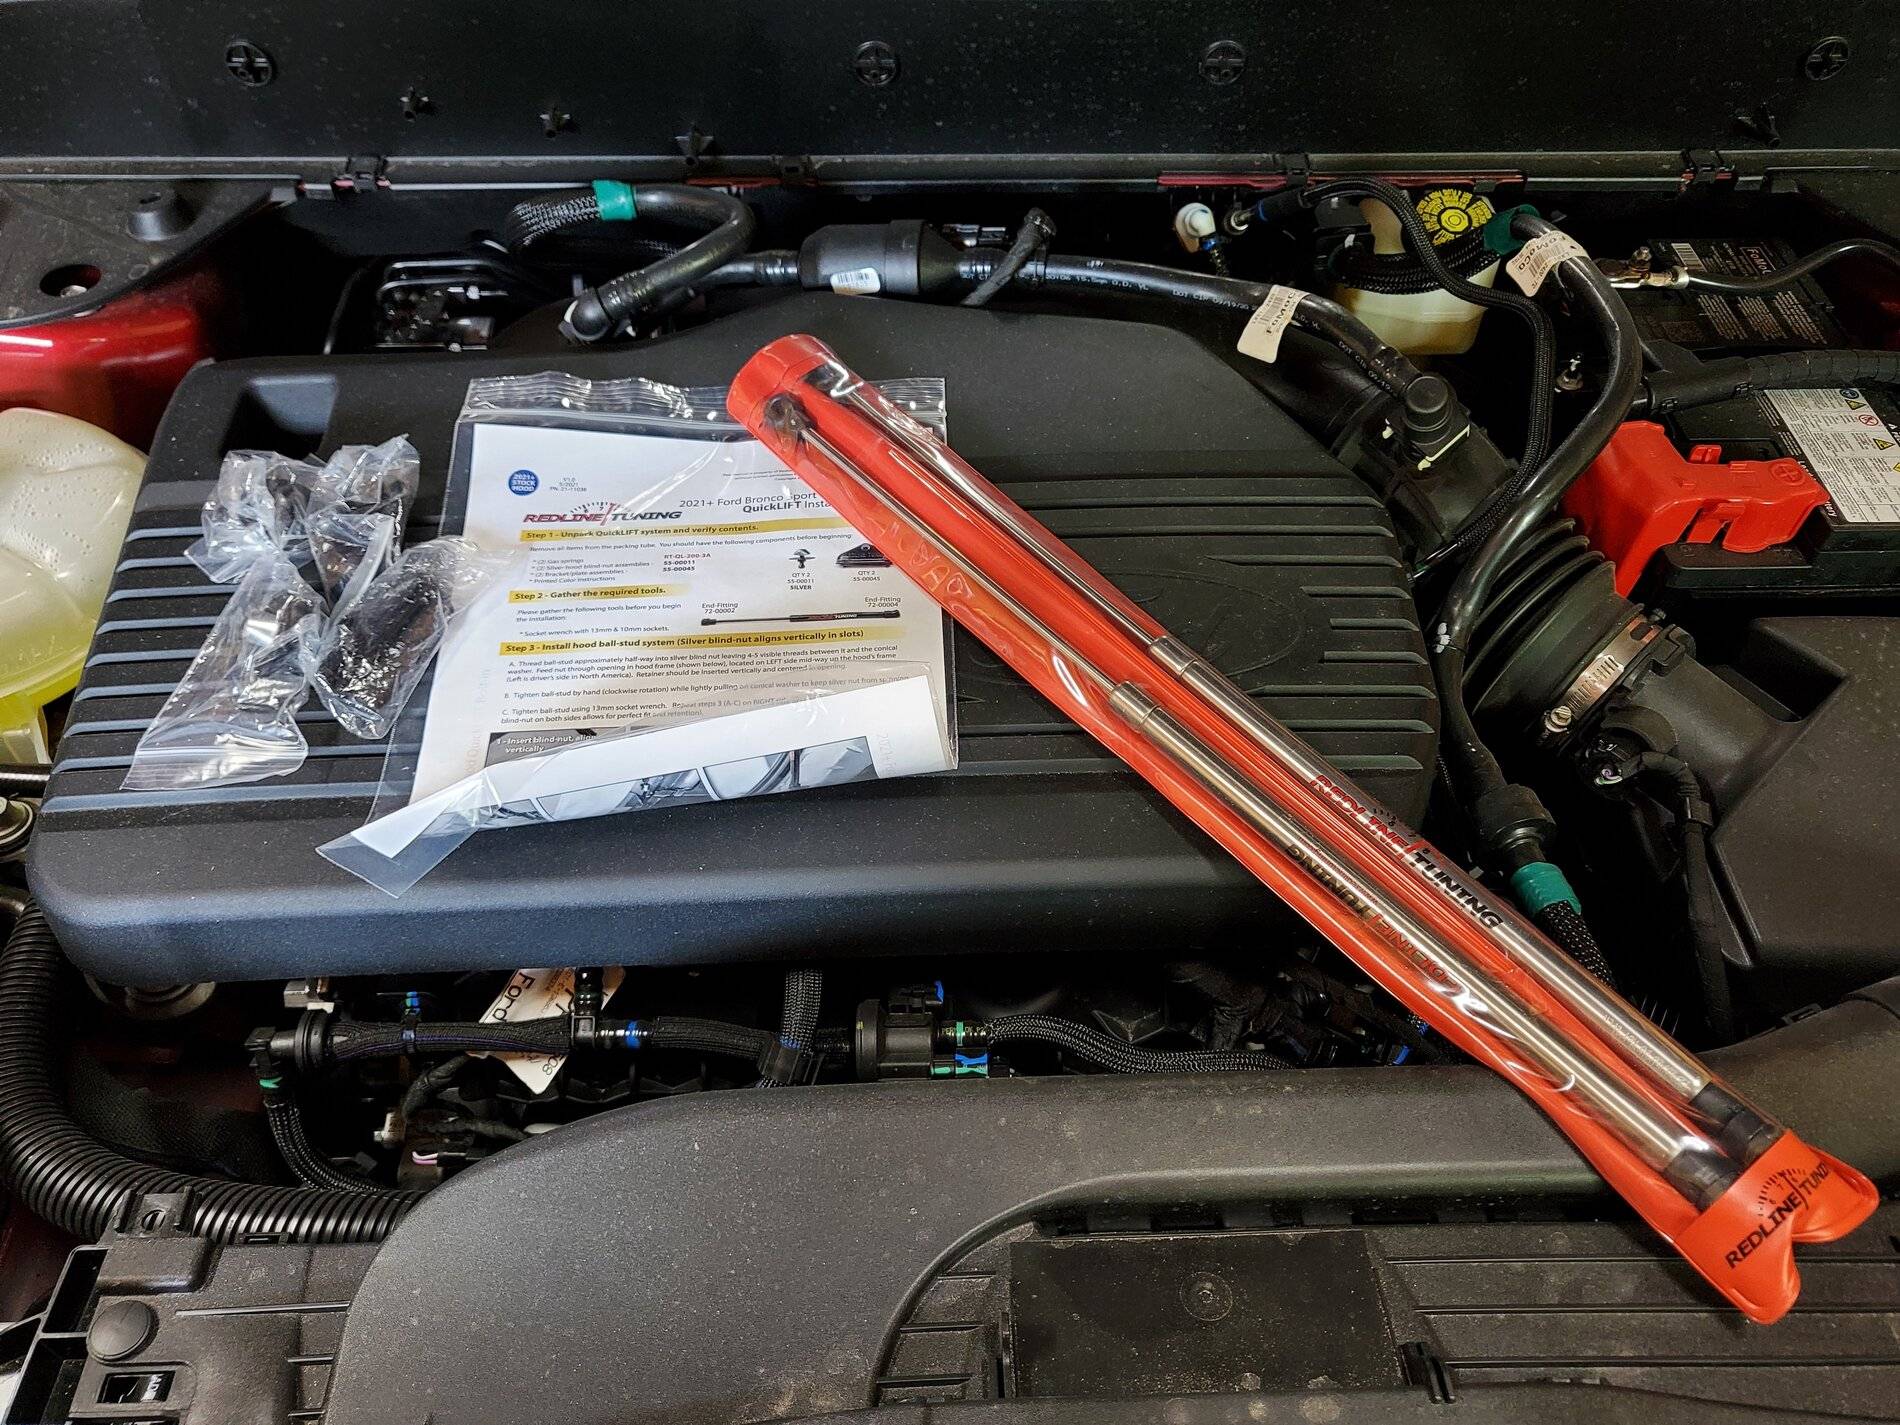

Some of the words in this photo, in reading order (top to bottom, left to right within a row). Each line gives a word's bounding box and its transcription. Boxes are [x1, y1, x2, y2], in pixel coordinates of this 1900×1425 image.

[679, 500, 714, 508] 2021+
[717, 496, 742, 506] Ford
[745, 495, 783, 504] Bronco
[787, 492, 816, 501] port
[743, 501, 801, 513] QuickLIFT
[523, 513, 603, 523] REDLINE
[612, 512, 683, 520] TUNING
[596, 529, 639, 537] QuickLIFT
[641, 528, 671, 536] system
[724, 538, 754, 546] following
[756, 536, 795, 544] components
[515, 593, 535, 601] Step
[550, 591, 582, 599] Gather
[600, 588, 639, 597] required
[662, 602, 682, 610] begin
[506, 645, 527, 653] Step
[599, 639, 641, 647] ball-stud
[642, 639, 675, 648] system
[677, 637, 706, 646] (Silver
[708, 636, 752, 644] blind-nut
[754, 635, 781, 643] aligns
[783, 632, 826, 641] vertically
[839, 630, 864, 638] slots)
[575, 657, 623, 665] approximately
[624, 655, 653, 663] half-way
[597, 664, 625, 672] opening
[799, 656, 828, 664] mid-way
[731, 666, 761, 674] vertically
[602, 687, 637, 695] (clockwise
[639, 686, 669, 694] rotation)
[690, 684, 712, 692] lightly
[512, 708, 538, 716] Tighten
[617, 712, 642, 720] perfect
[1309, 774, 1410, 852] REDLINE
[1409, 851, 1505, 929] TUNING
[1725, 1190, 1802, 1269] REDLINE
